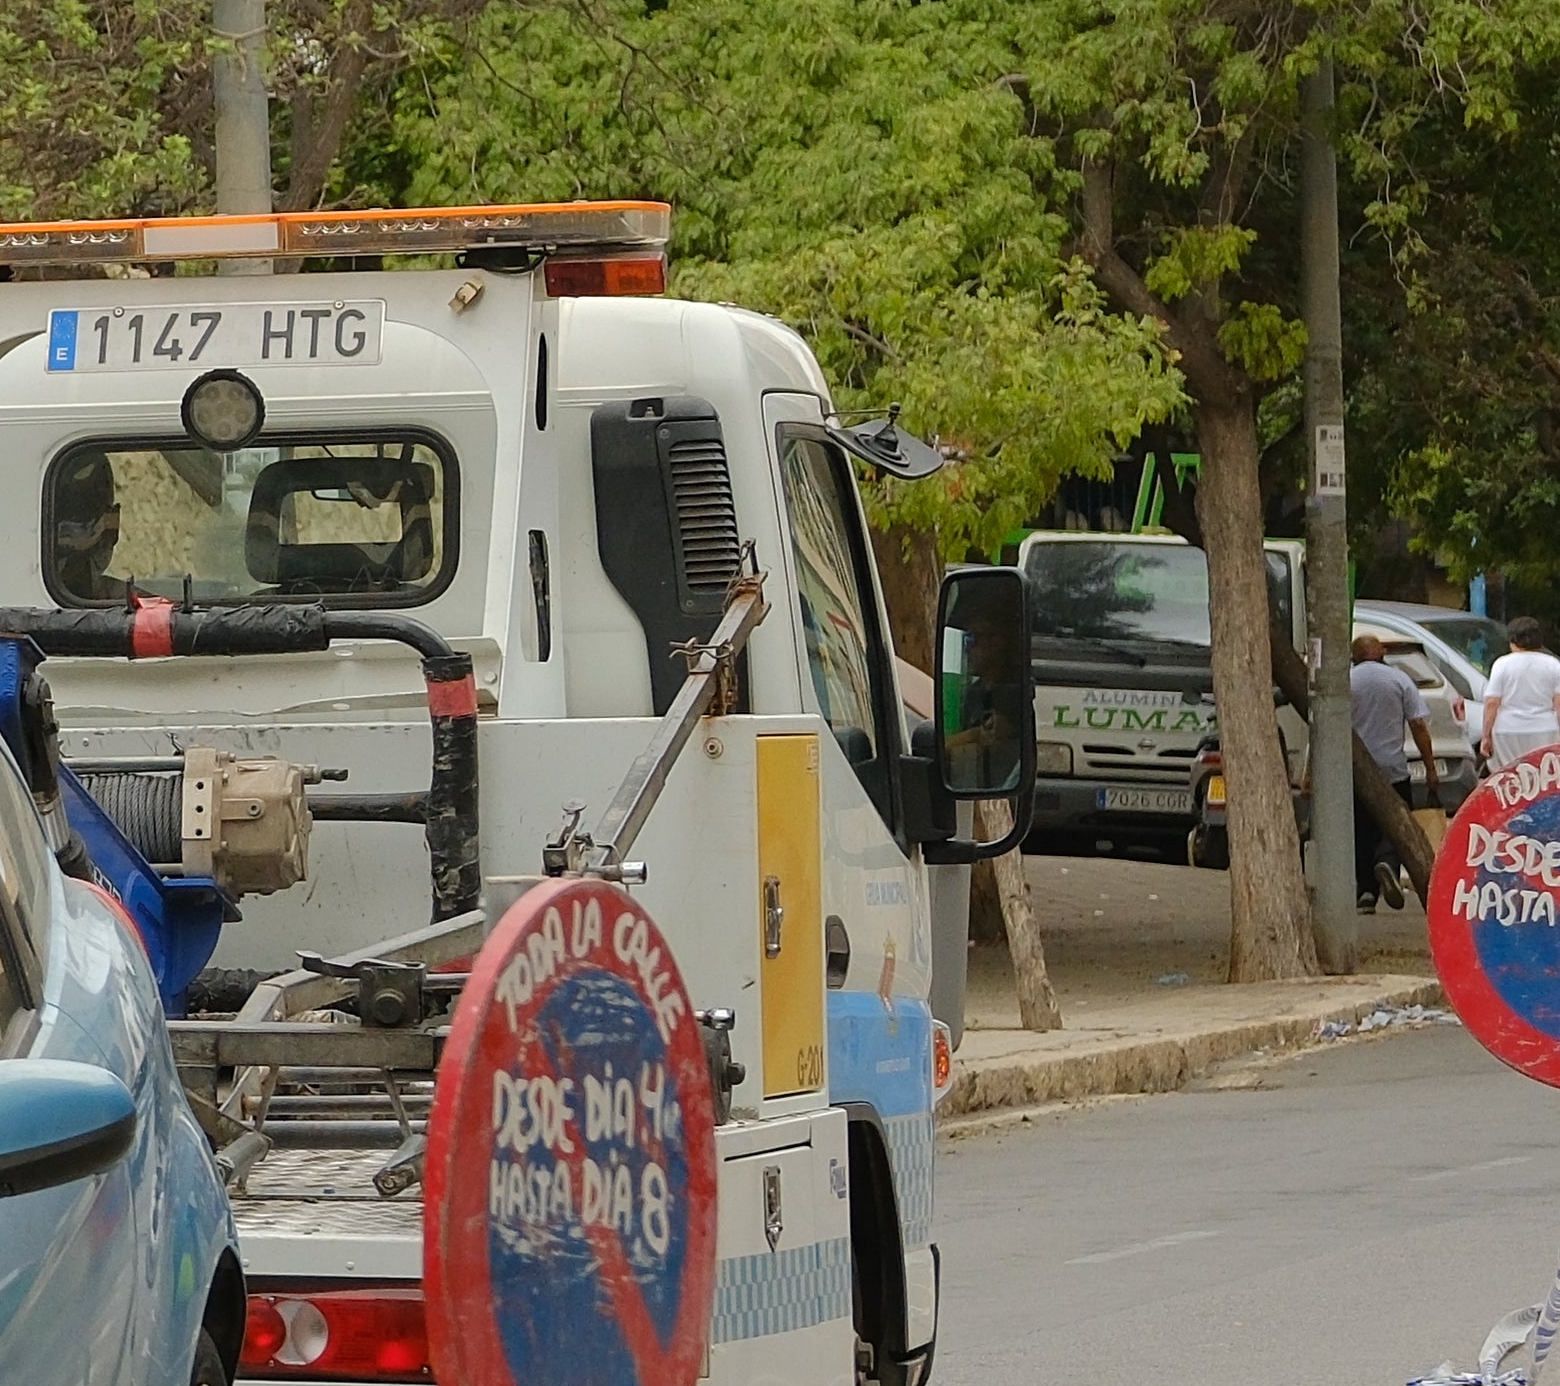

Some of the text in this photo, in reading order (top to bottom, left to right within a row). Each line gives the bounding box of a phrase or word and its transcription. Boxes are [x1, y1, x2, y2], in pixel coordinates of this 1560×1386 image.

[93, 312, 222, 364] 1147
[262, 309, 367, 360] HTG
[1053, 705, 1218, 731] LUMA
[1082, 690, 1186, 706] ALUMIN
[1485, 751, 1560, 810] TODA
[1466, 823, 1560, 887] DESDE
[1452, 878, 1555, 927] HASTA
[495, 897, 686, 1045] TODA LA CALLE
[492, 1069, 575, 1154] DESDE
[489, 1159, 575, 1225] HASTA
[641, 1162, 671, 1256] 8
